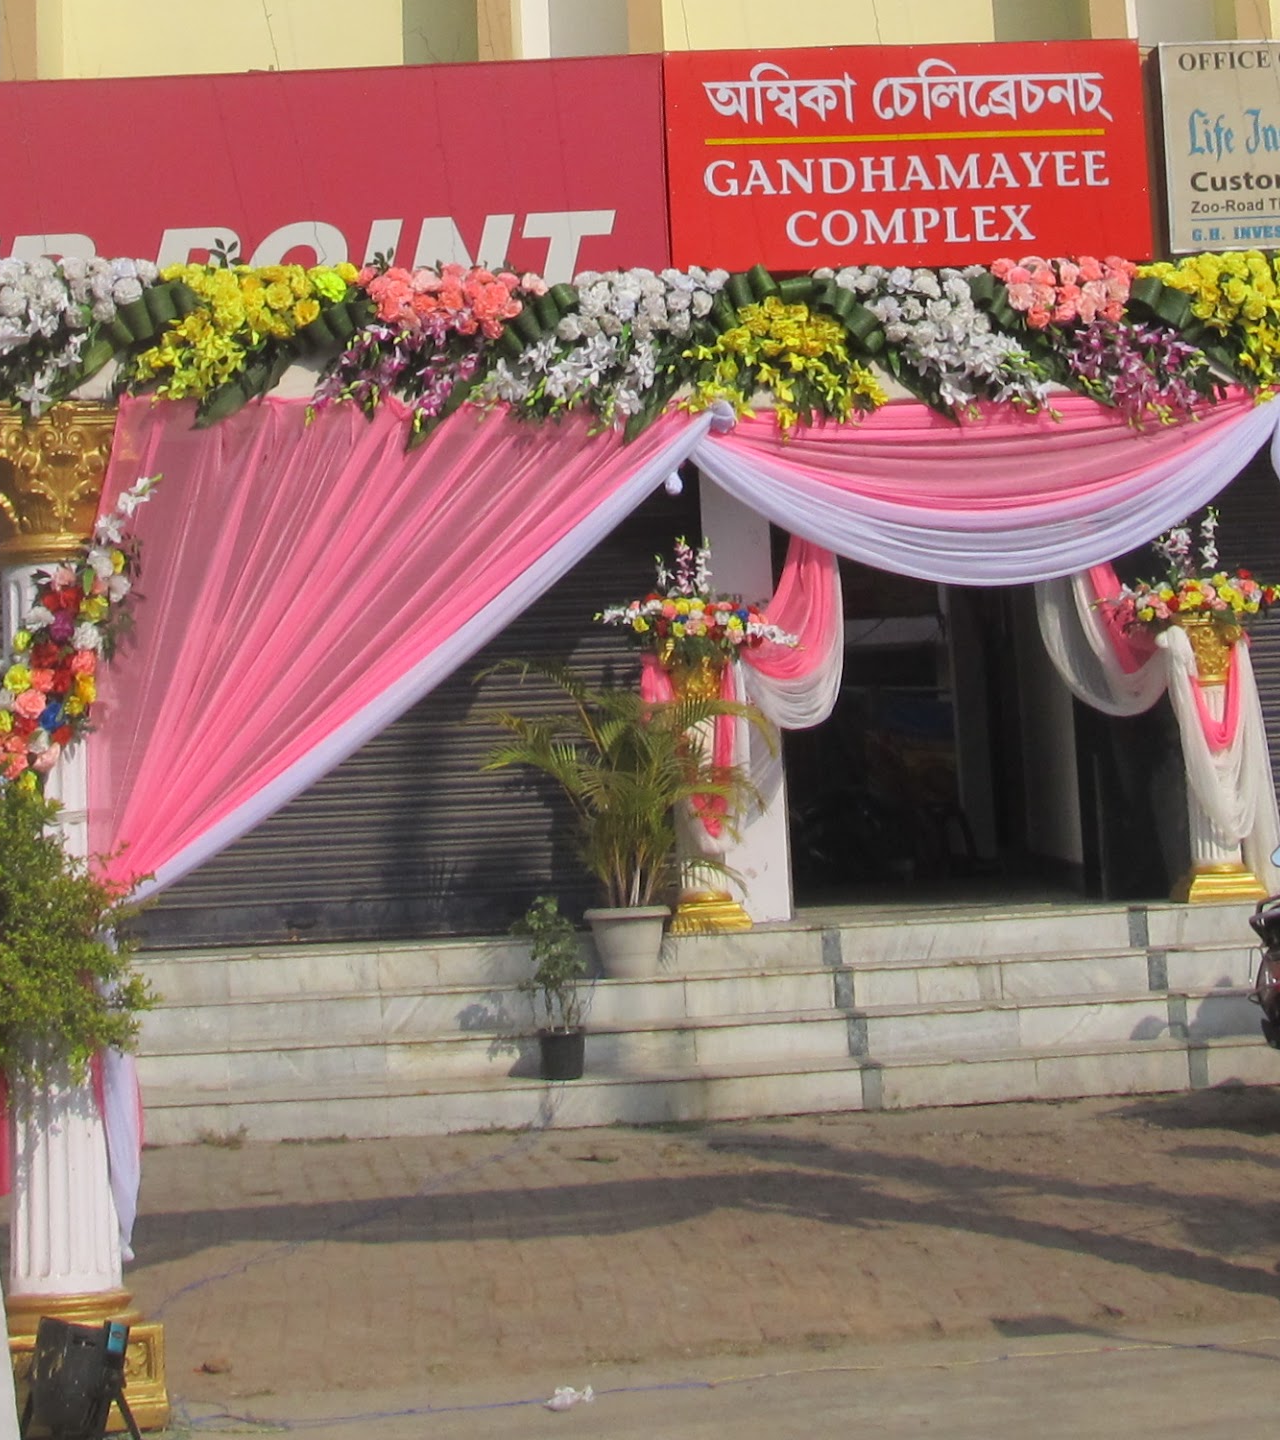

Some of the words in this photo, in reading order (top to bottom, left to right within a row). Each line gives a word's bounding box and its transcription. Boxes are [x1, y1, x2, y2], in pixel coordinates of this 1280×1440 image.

[1178, 50, 1271, 72] OFFICE
[701, 61, 857, 128] অম্বিকা
[1187, 107, 1235, 163] Life
[703, 150, 1111, 198] GANDHAMAYEE
[784, 204, 1036, 248] COMPLEX
[1190, 198, 1265, 215] Zoo-Road
